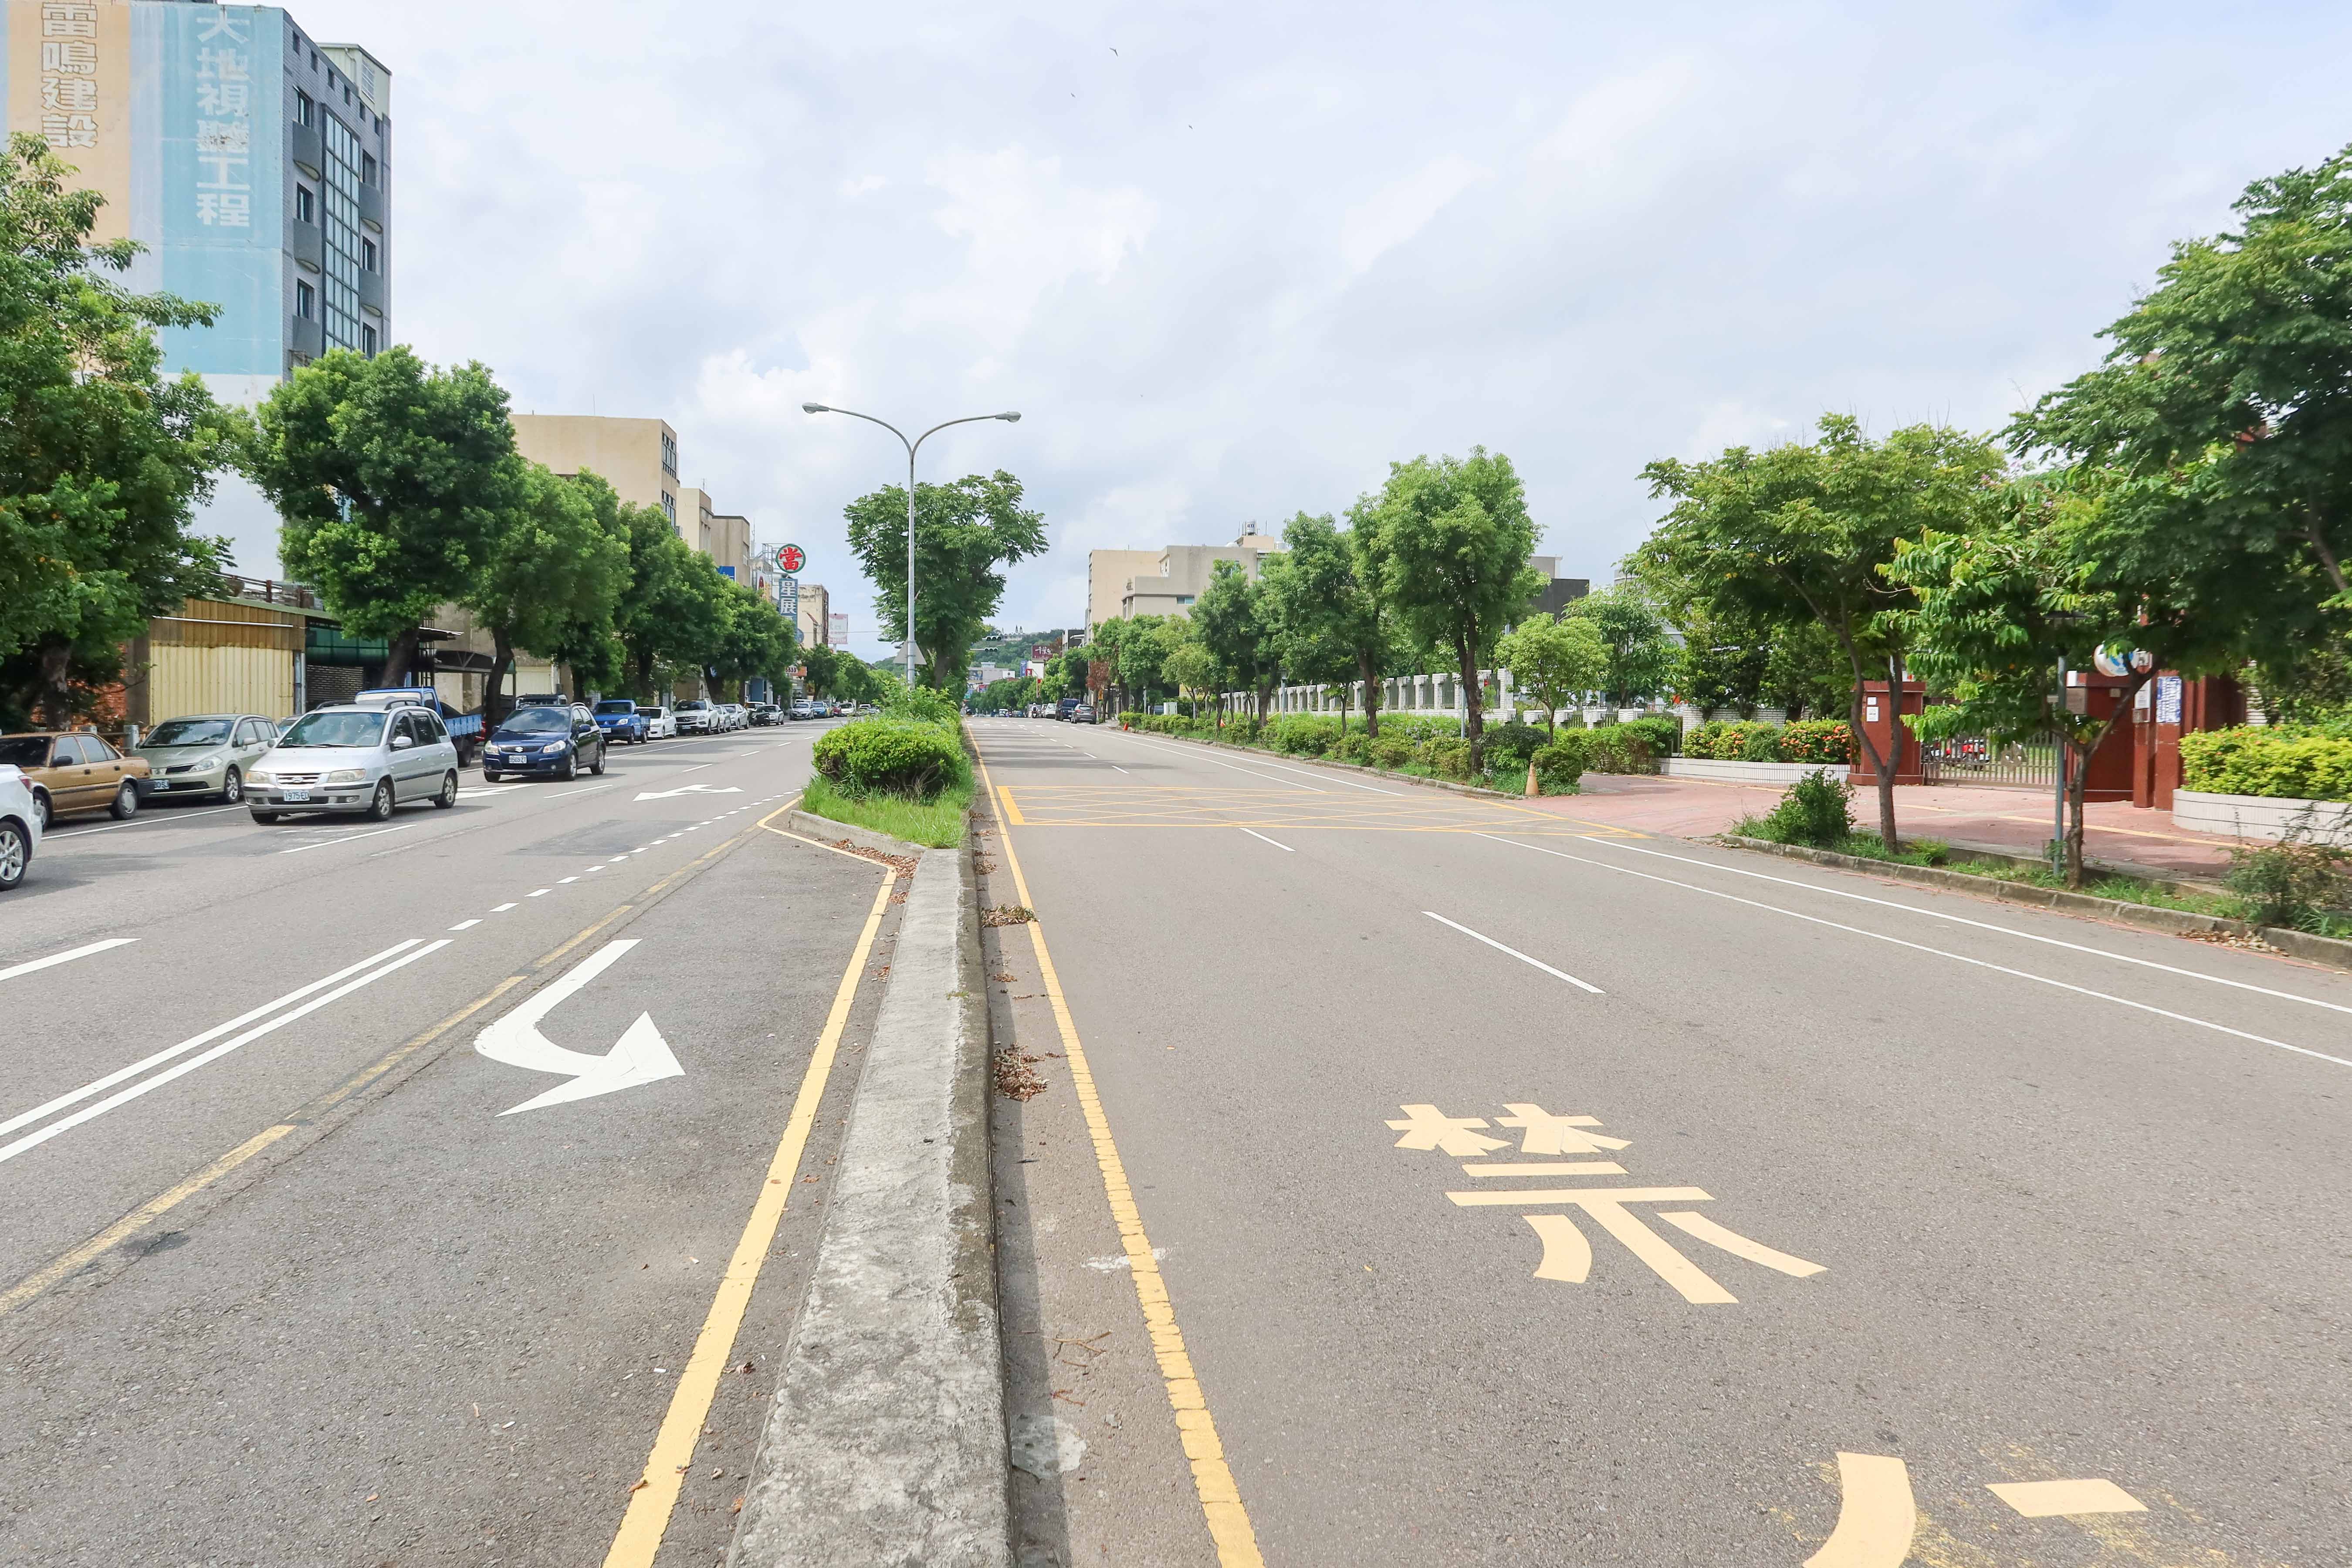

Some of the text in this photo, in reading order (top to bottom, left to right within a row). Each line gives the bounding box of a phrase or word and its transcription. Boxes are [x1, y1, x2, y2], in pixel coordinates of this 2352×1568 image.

[41, 2, 98, 149] 雷鳴建設
[779, 547, 802, 570] 當
[781, 580, 797, 619] 星展
[1384, 1103, 1827, 1304] 禁
